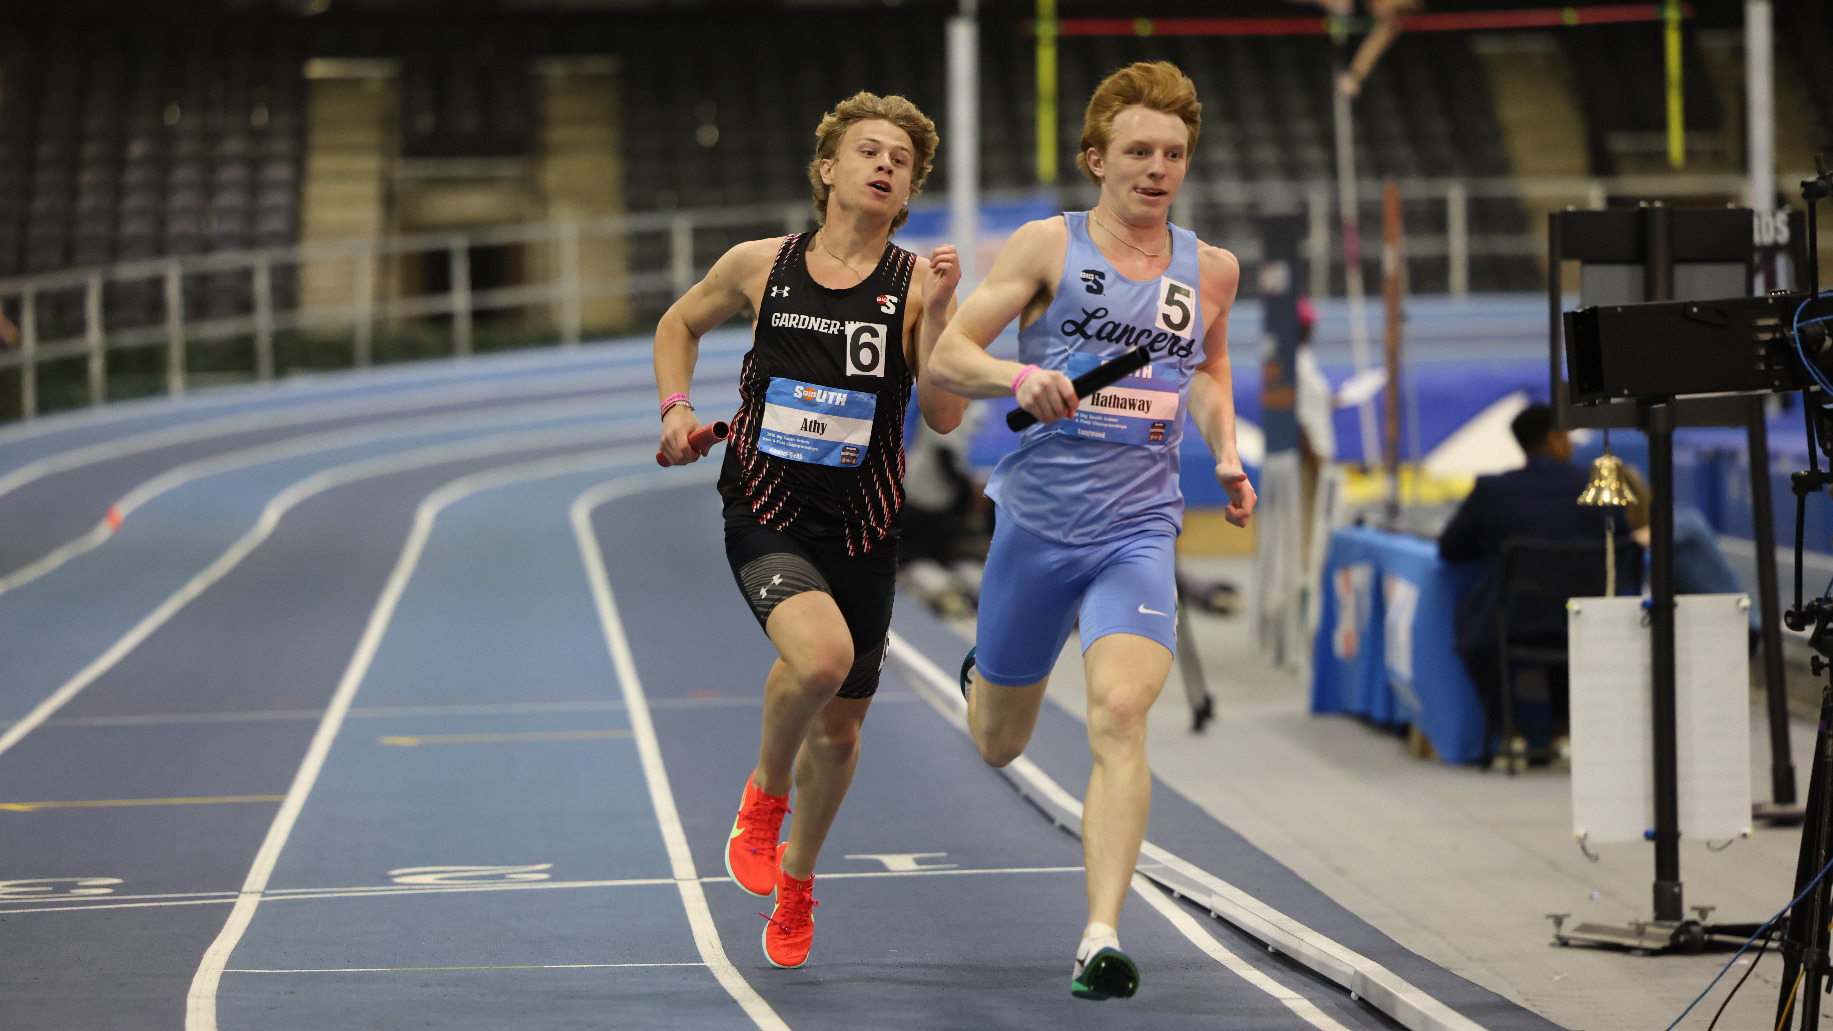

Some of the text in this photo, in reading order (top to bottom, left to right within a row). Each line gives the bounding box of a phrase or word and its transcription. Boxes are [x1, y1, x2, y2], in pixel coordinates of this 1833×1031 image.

[1080, 271, 1095, 280] BIG
[1161, 283, 1191, 332] 5
[849, 325, 880, 373] 6
[1061, 307, 1196, 359] Lancers
[1090, 392, 1153, 414] Hathaway
[800, 417, 828, 436] Athy
